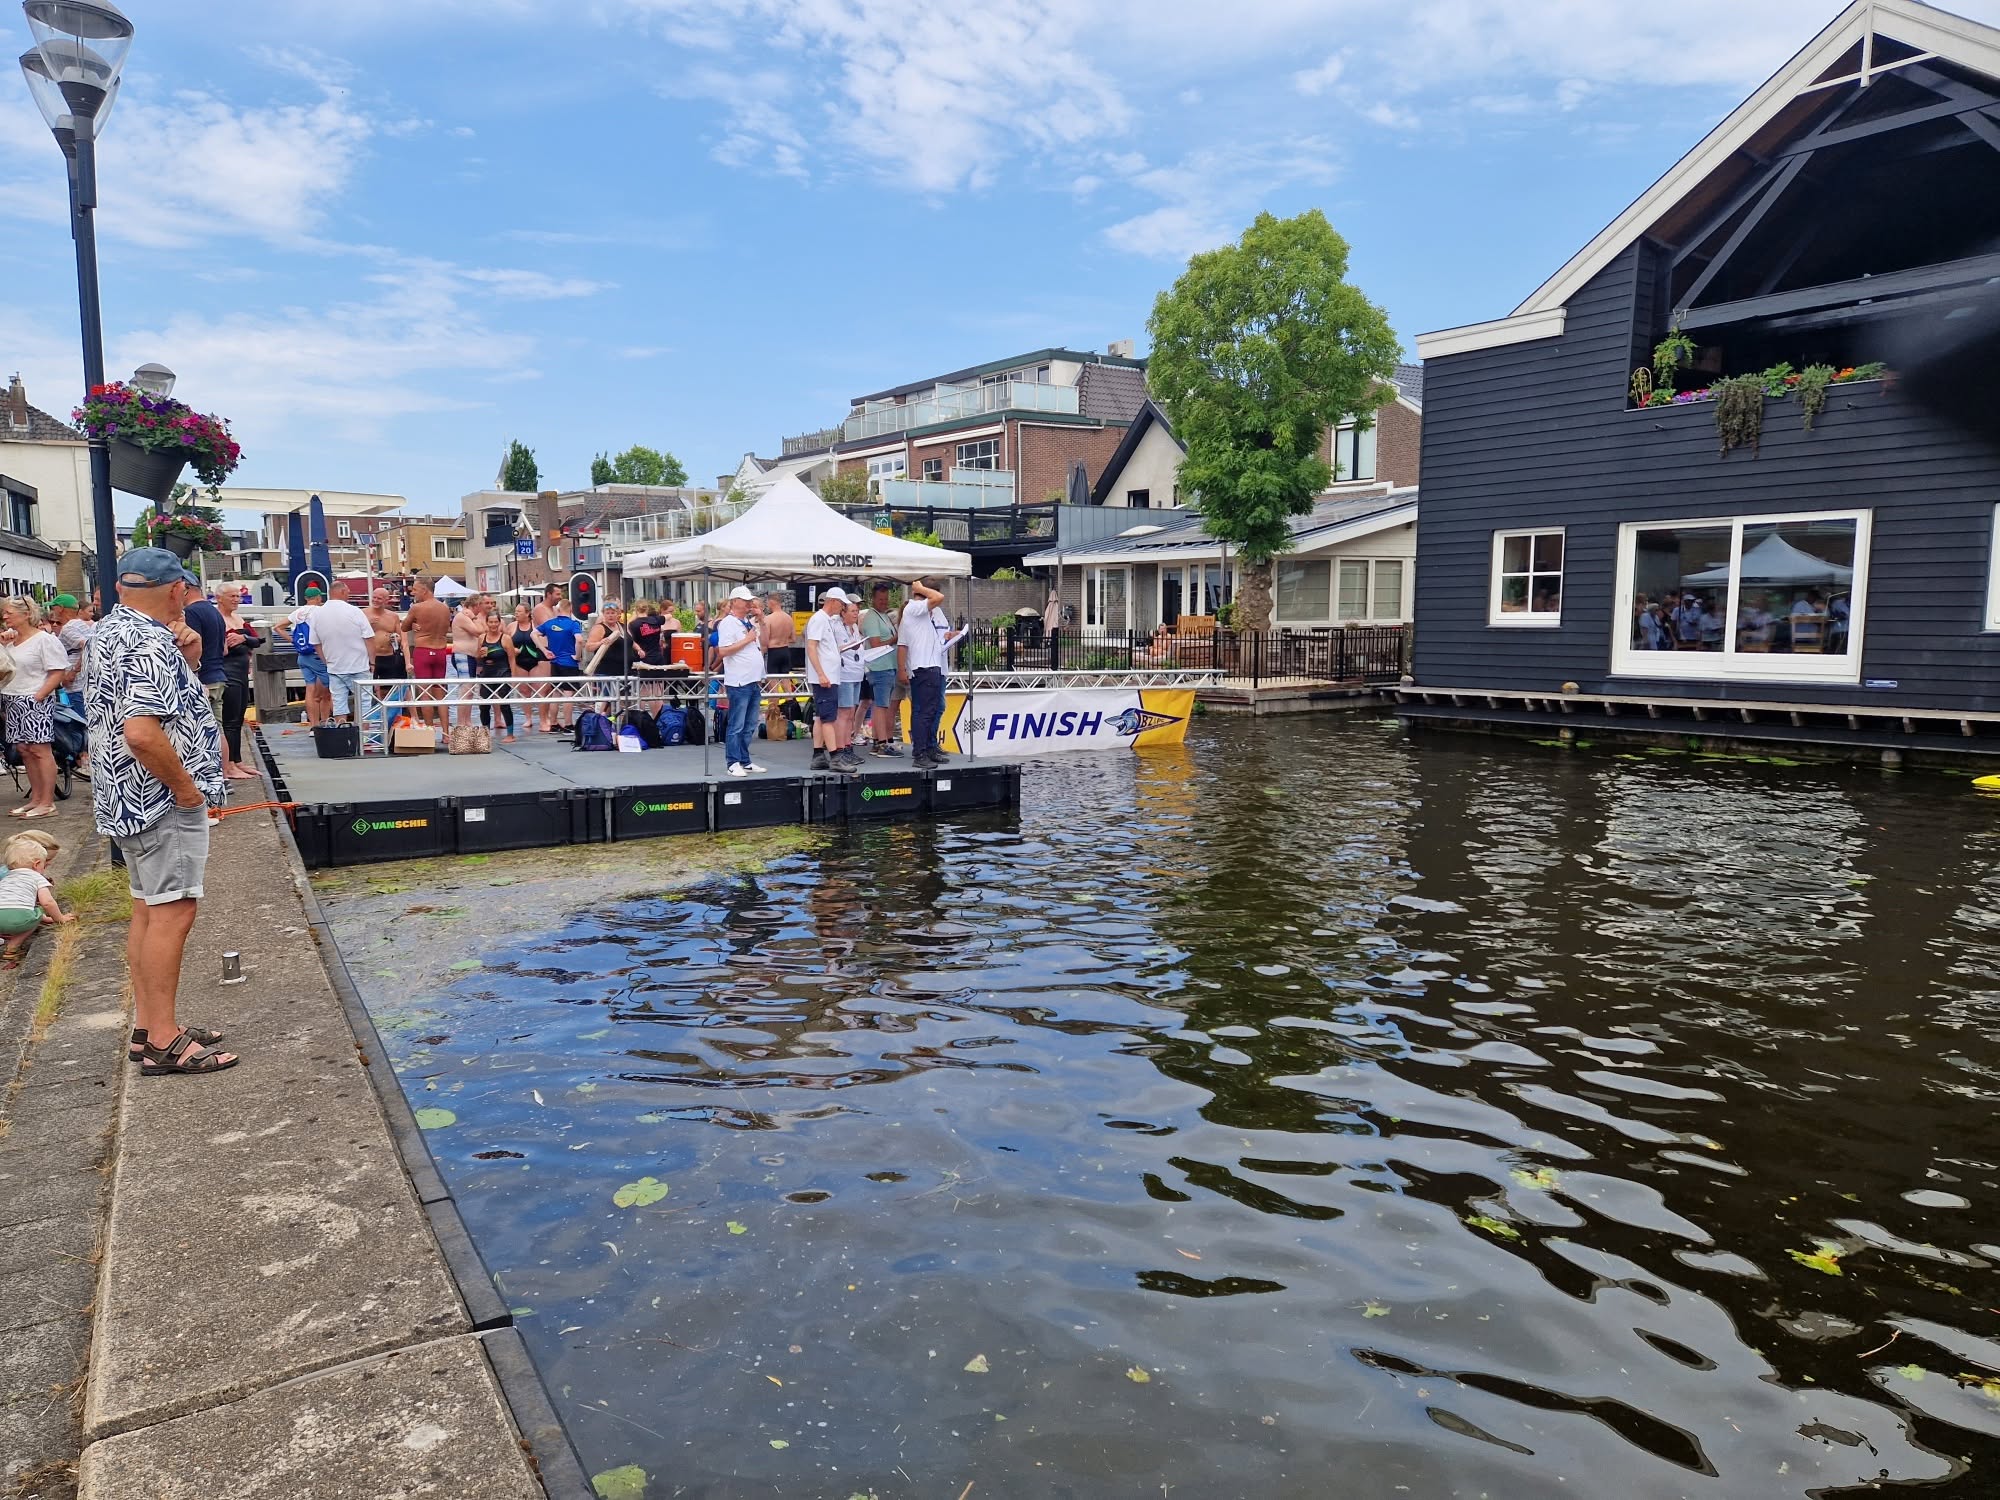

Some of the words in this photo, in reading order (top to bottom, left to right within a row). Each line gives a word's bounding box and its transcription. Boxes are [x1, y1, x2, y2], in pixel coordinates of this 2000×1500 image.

[812, 554, 873, 568] IRONSIDE
[986, 711, 1103, 741] FINISH
[648, 802, 694, 812] VANSCHIE
[371, 819, 428, 830] VANSCHIE
